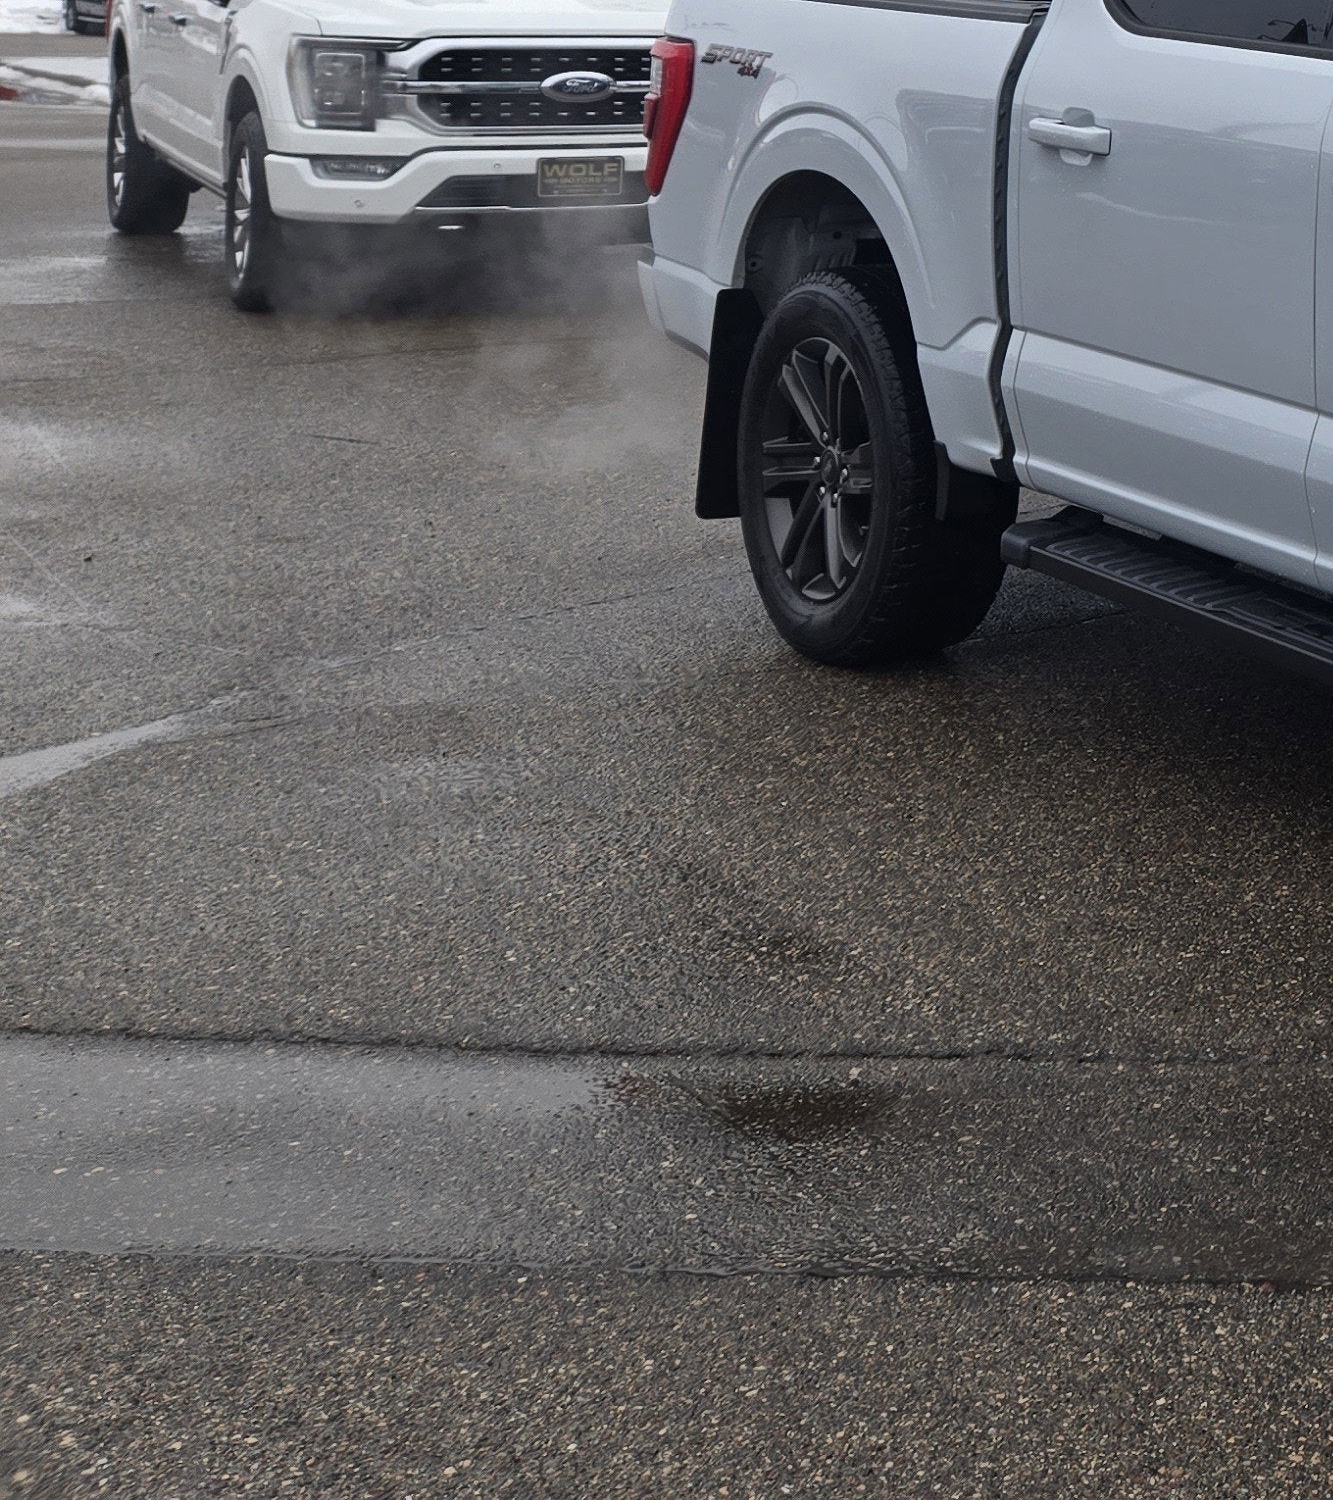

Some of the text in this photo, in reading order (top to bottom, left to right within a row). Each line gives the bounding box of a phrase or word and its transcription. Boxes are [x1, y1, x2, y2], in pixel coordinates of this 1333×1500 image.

[700, 43, 774, 69] SPORT
[562, 79, 599, 94] Ford
[542, 162, 620, 177] WOLF
